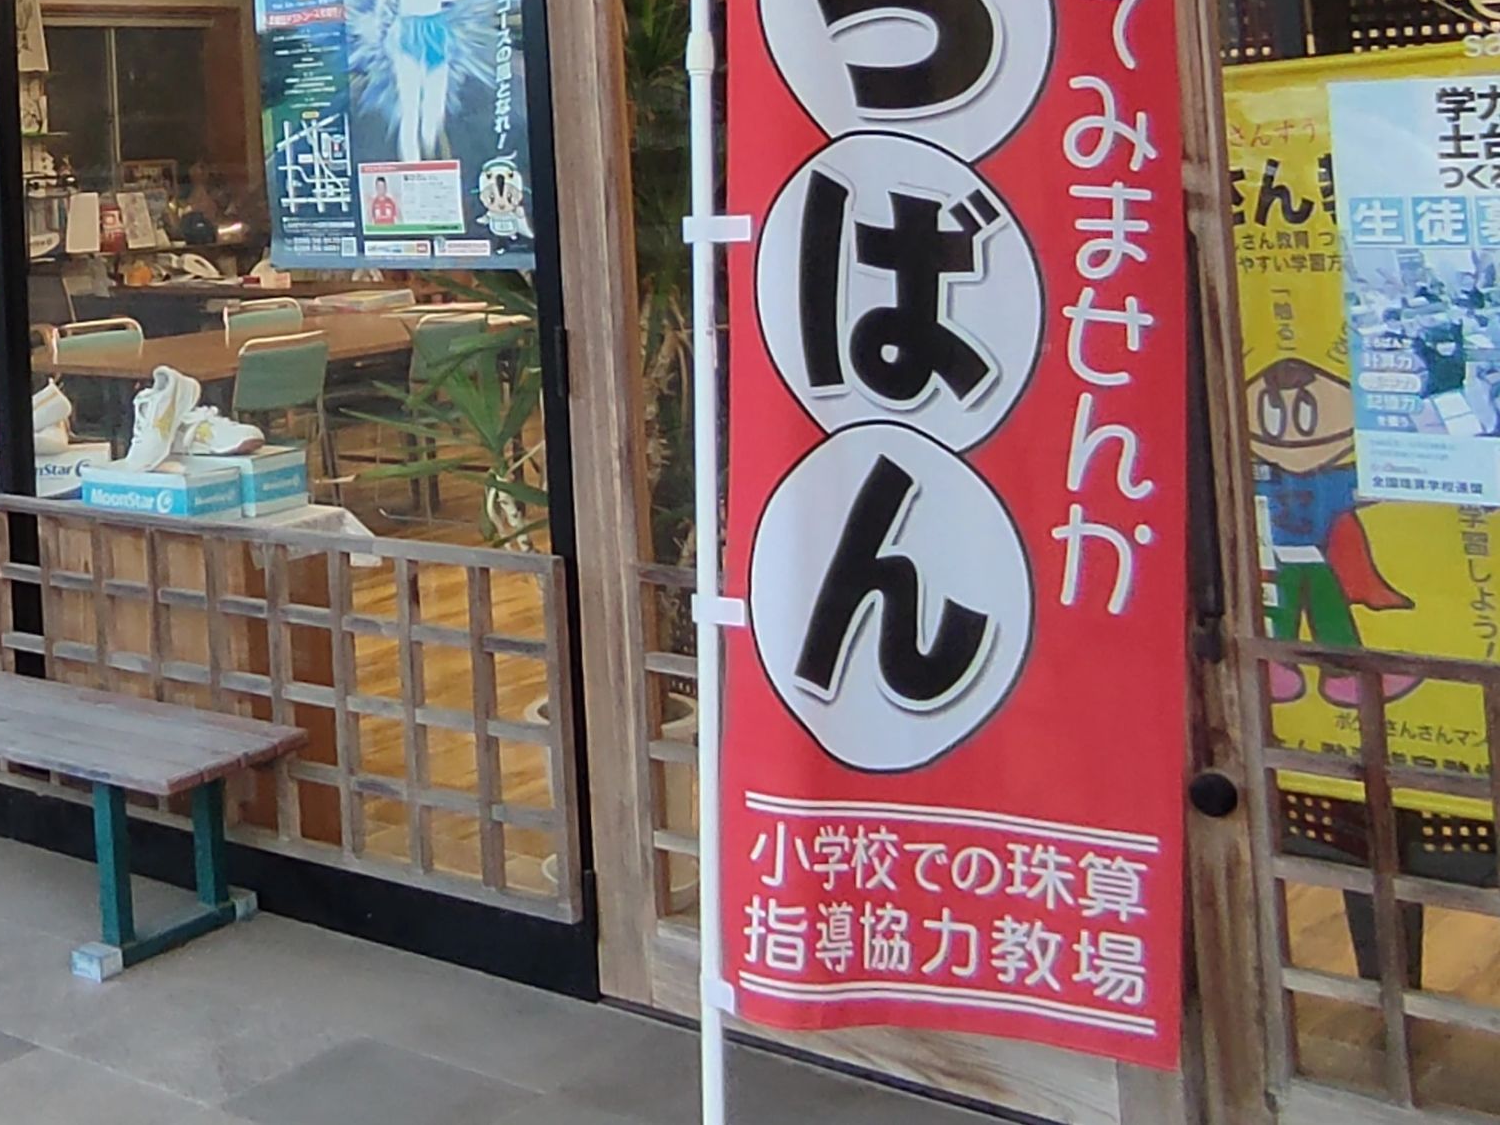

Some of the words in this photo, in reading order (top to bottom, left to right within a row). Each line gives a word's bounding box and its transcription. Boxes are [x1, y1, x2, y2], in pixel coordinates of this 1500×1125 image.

[90, 487, 155, 510] MoonStar
[749, 821, 1148, 923] 小学校での珠算
[743, 895, 1148, 1006] 指導協力教場
